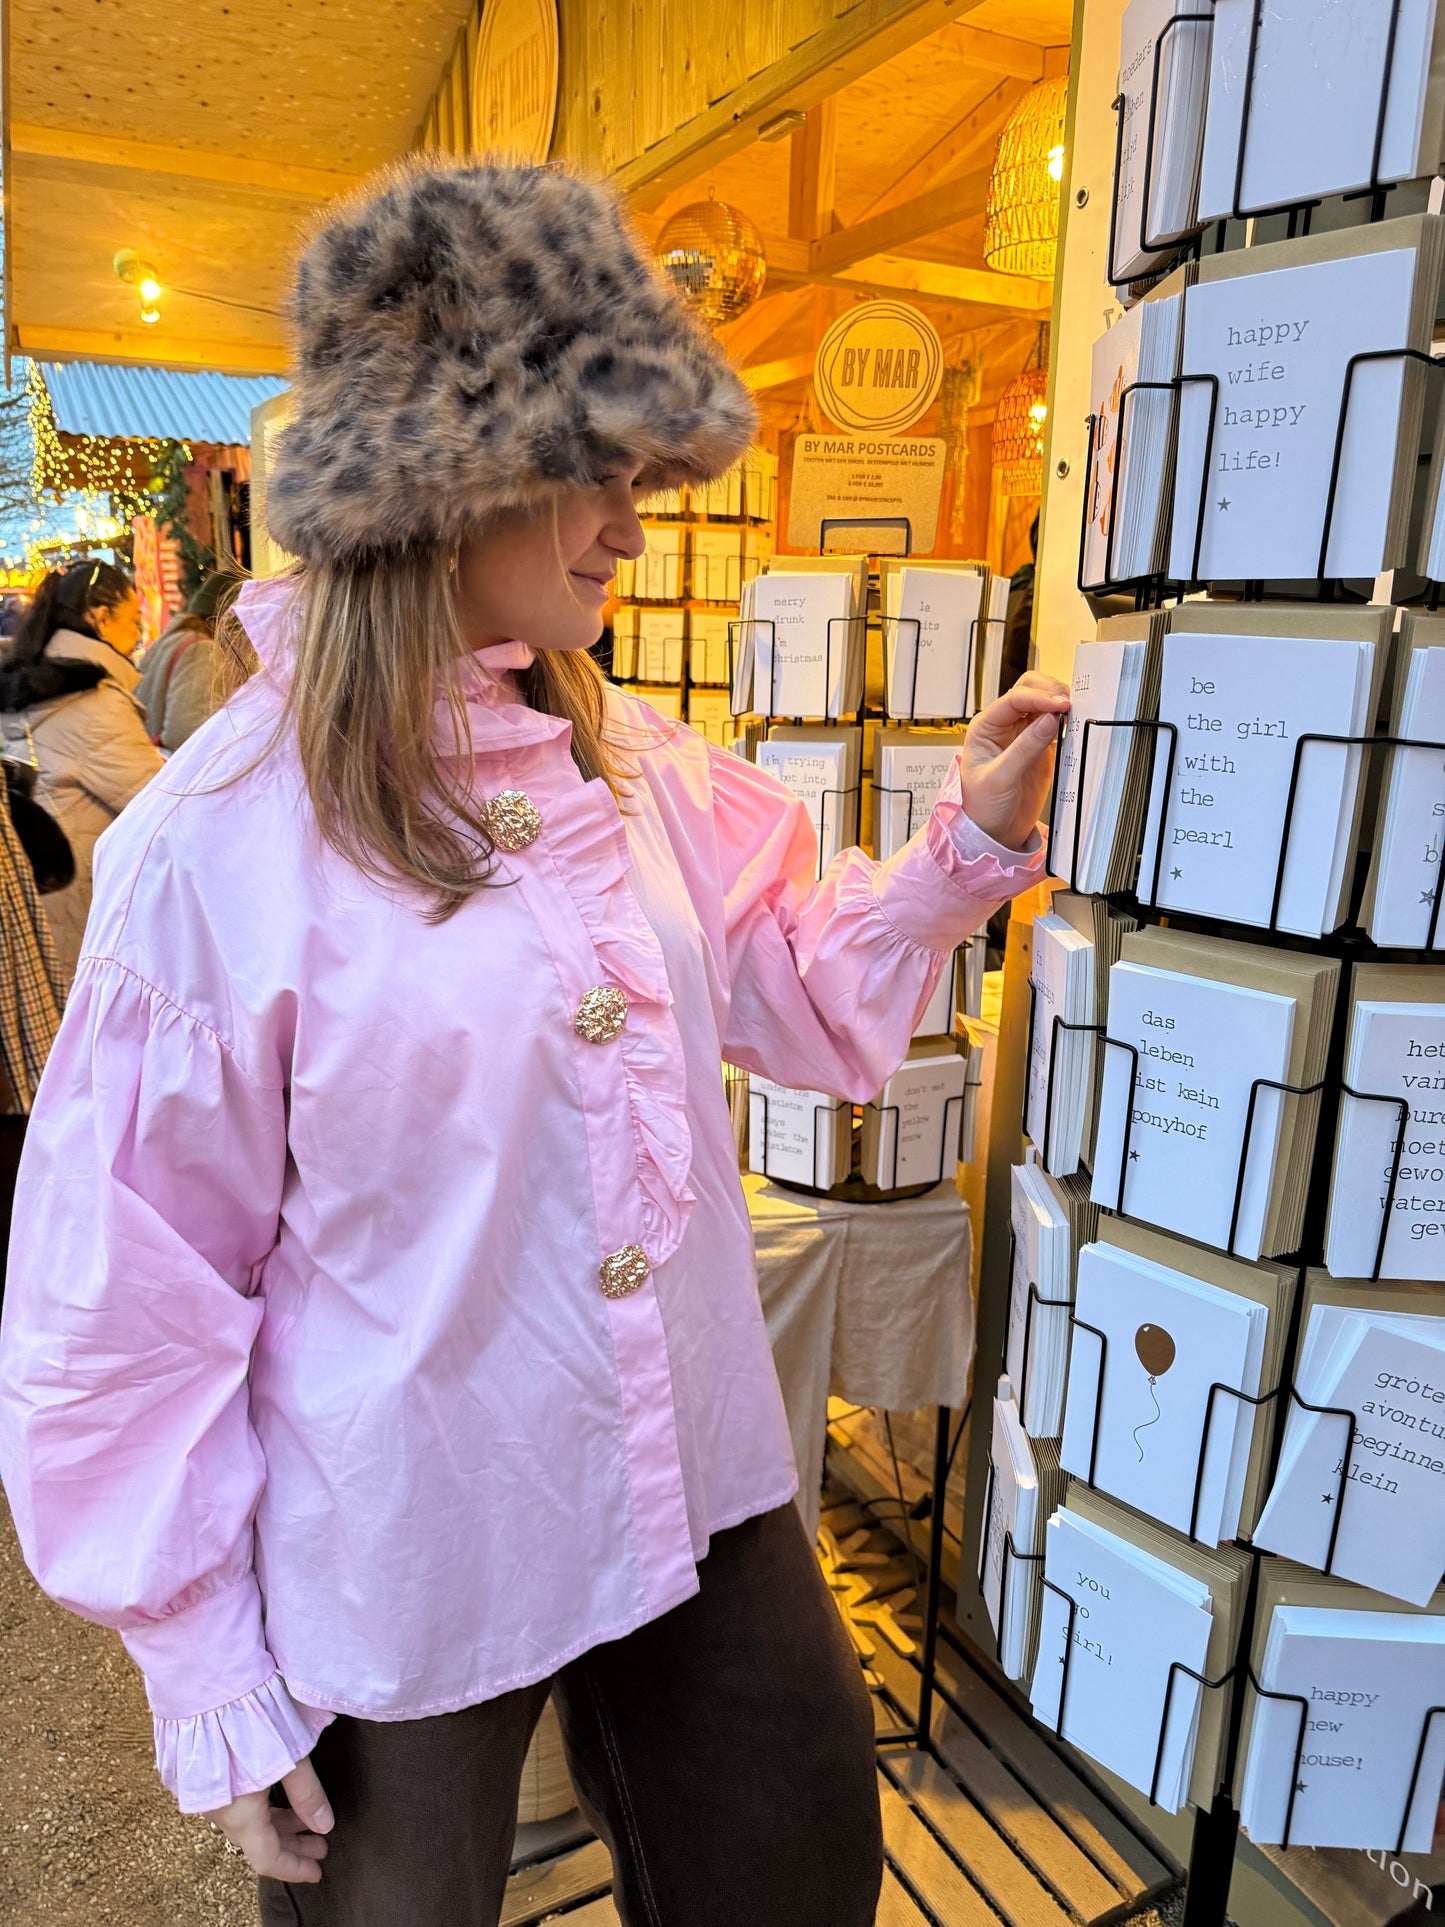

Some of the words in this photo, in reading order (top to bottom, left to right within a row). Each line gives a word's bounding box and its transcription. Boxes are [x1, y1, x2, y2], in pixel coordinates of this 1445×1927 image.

[1227, 319, 1310, 347] happy
[841, 348, 871, 388] BY
[872, 348, 921, 389] MAR
[1227, 360, 1286, 386] wife
[1223, 404, 1306, 429] happy
[804, 440, 821, 453] BY
[823, 441, 855, 455] MAR
[858, 442, 937, 458] POSTCARDS
[1218, 450, 1281, 472] life!
[774, 598, 807, 608] merry
[920, 601, 931, 612] le
[1189, 676, 1216, 695] be
[1186, 713, 1223, 732] the
[1236, 717, 1289, 740] girl
[787, 757, 826, 770] trying
[906, 764, 925, 775] may
[931, 764, 949, 775] you
[1184, 753, 1236, 774] with
[803, 773, 827, 786] into
[906, 779, 942, 791] sparkl
[1180, 788, 1214, 807] the
[1171, 827, 1234, 849] pearl
[1141, 1010, 1175, 1030] das
[1140, 1039, 1195, 1067] leben
[1135, 1072, 1166, 1093] ist
[1177, 1082, 1220, 1109] kein
[1131, 1109, 1208, 1140] ponyhof
[1362, 1401, 1445, 1440] avontu
[1352, 1427, 1445, 1475] beginne
[1076, 1571, 1110, 1601] you
[1310, 1686, 1381, 1708] happy
